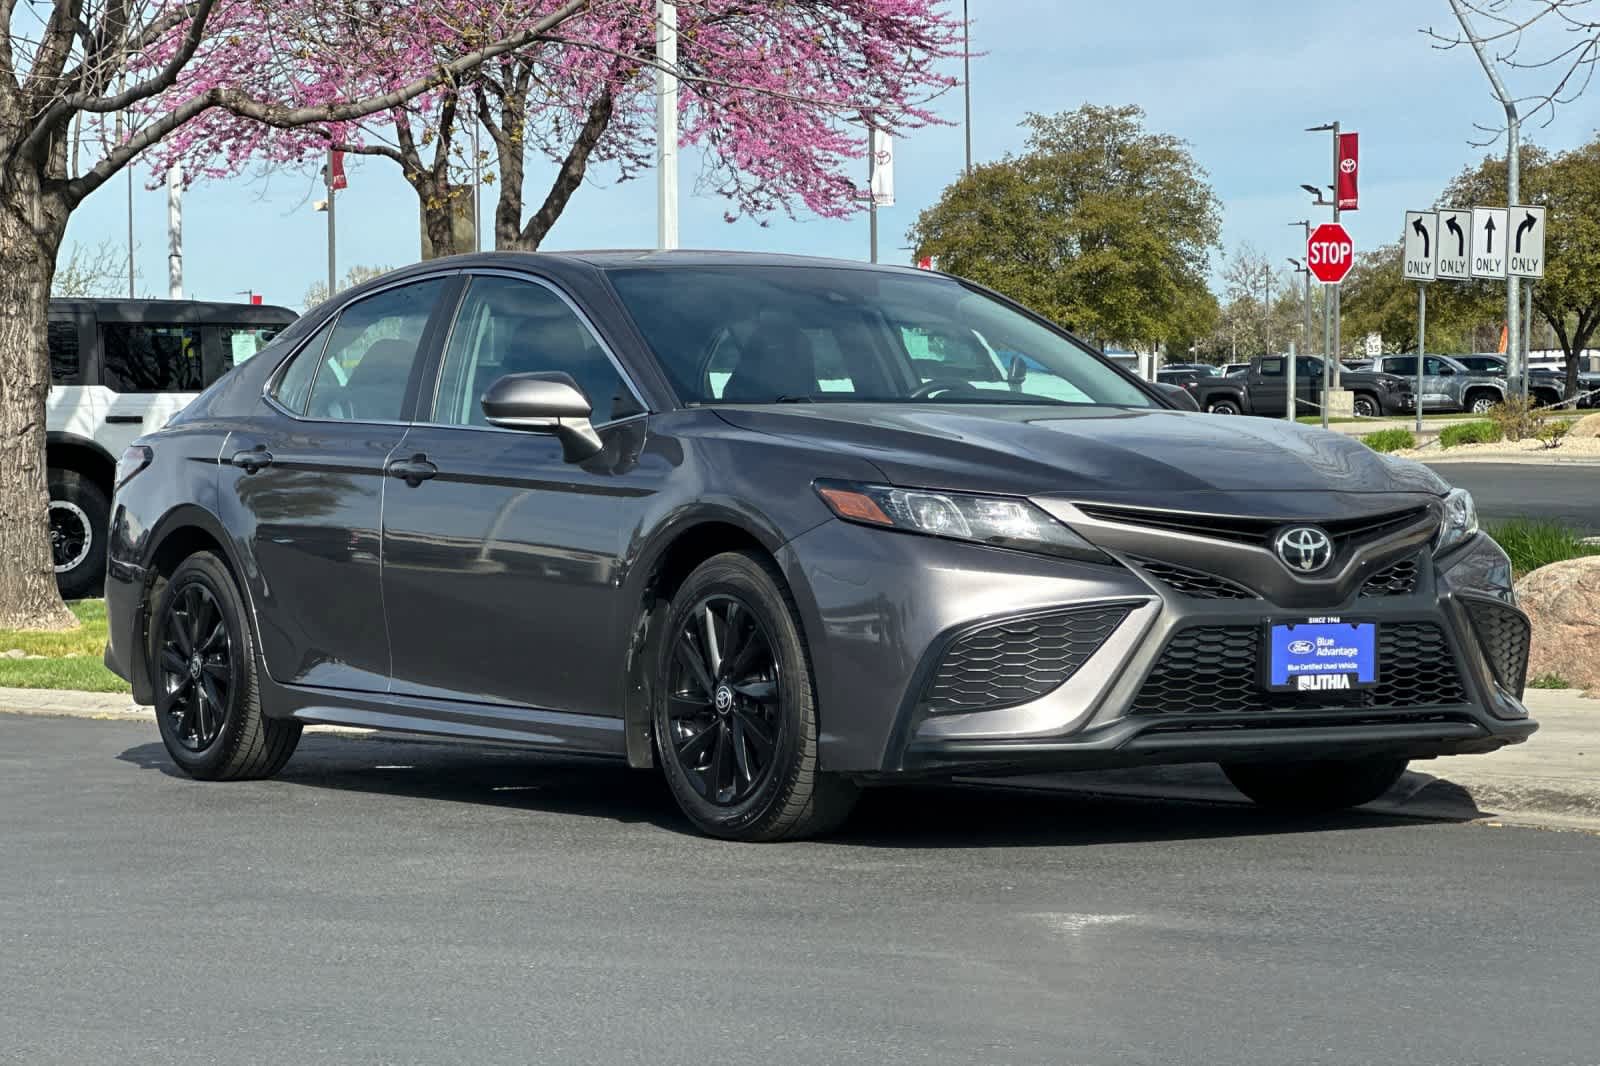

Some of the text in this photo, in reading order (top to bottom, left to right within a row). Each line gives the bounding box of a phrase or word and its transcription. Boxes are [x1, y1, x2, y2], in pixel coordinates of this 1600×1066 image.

[1309, 241, 1351, 265] STOP
[1407, 260, 1432, 274] ONLY
[1440, 259, 1466, 274] ONLY
[1476, 257, 1501, 272] ONLY
[1511, 257, 1538, 272] ONLY
[1308, 616, 1326, 624] SINCE
[1316, 637, 1335, 646] Blue
[1316, 647, 1358, 658] Advantage
[1287, 663, 1300, 671] Blue
[1300, 663, 1323, 671] Certified
[1310, 673, 1350, 690] LITHIA
